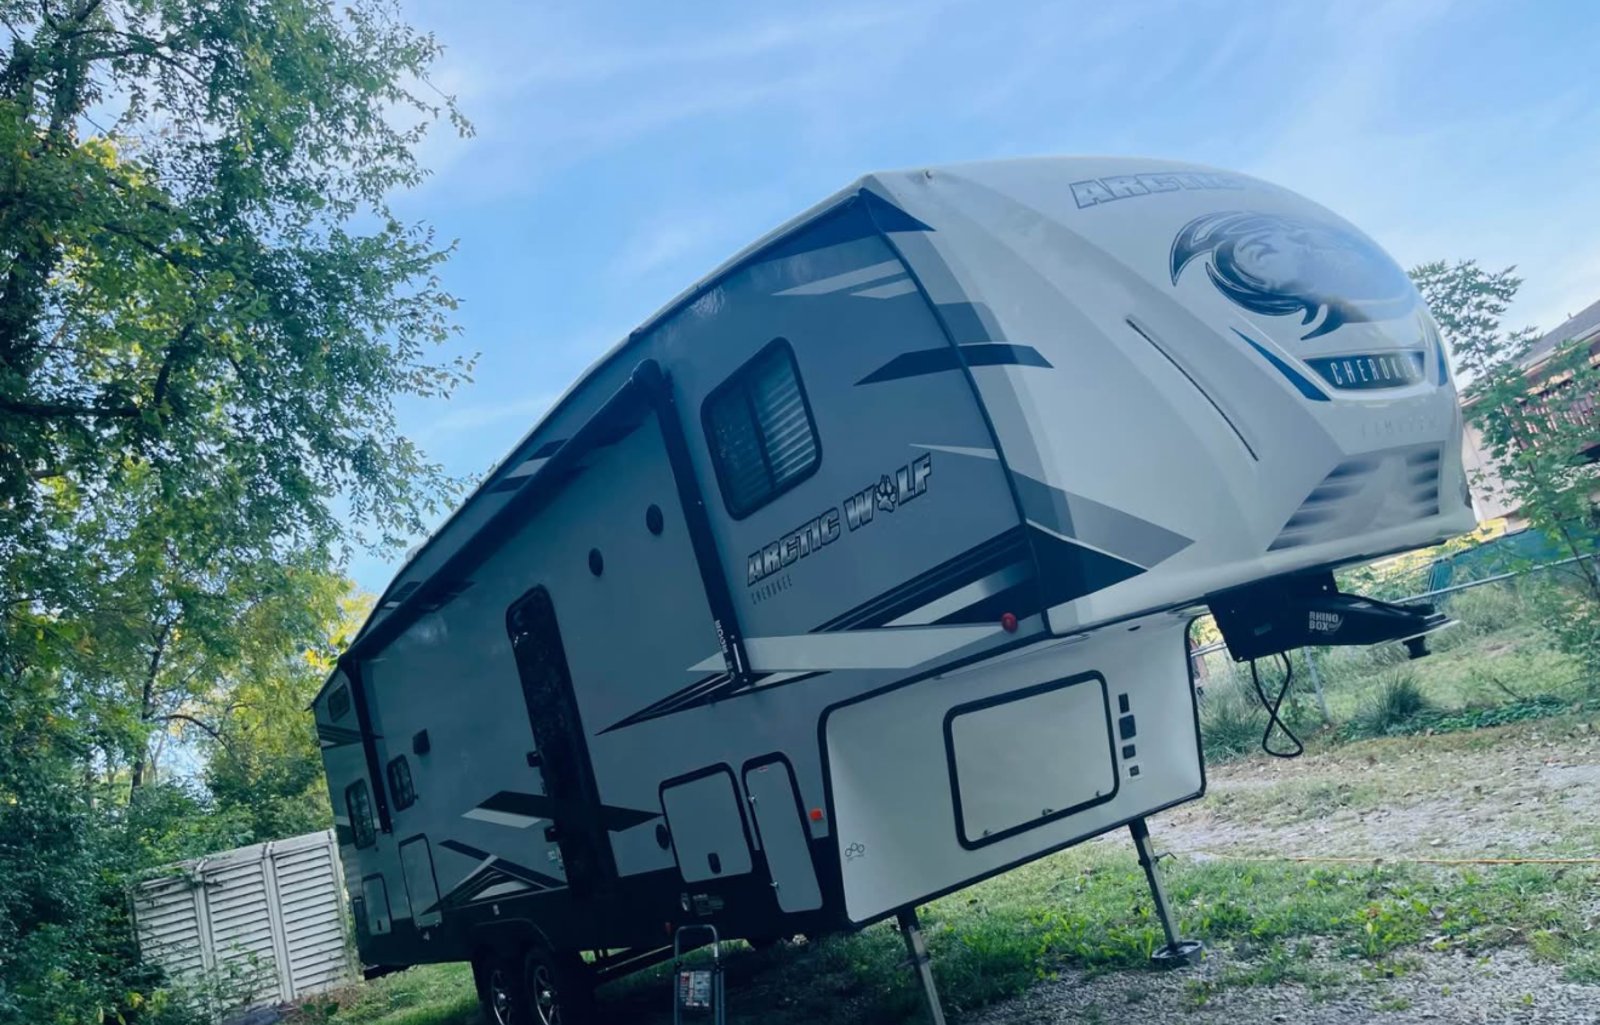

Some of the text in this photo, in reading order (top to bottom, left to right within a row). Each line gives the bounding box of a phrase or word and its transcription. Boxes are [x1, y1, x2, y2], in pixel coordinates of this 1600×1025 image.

[747, 506, 841, 588] ARCTIC
[751, 574, 793, 605] CHEROKEE
[1308, 611, 1339, 623] RHINO
[1308, 620, 1329, 631] BOX
